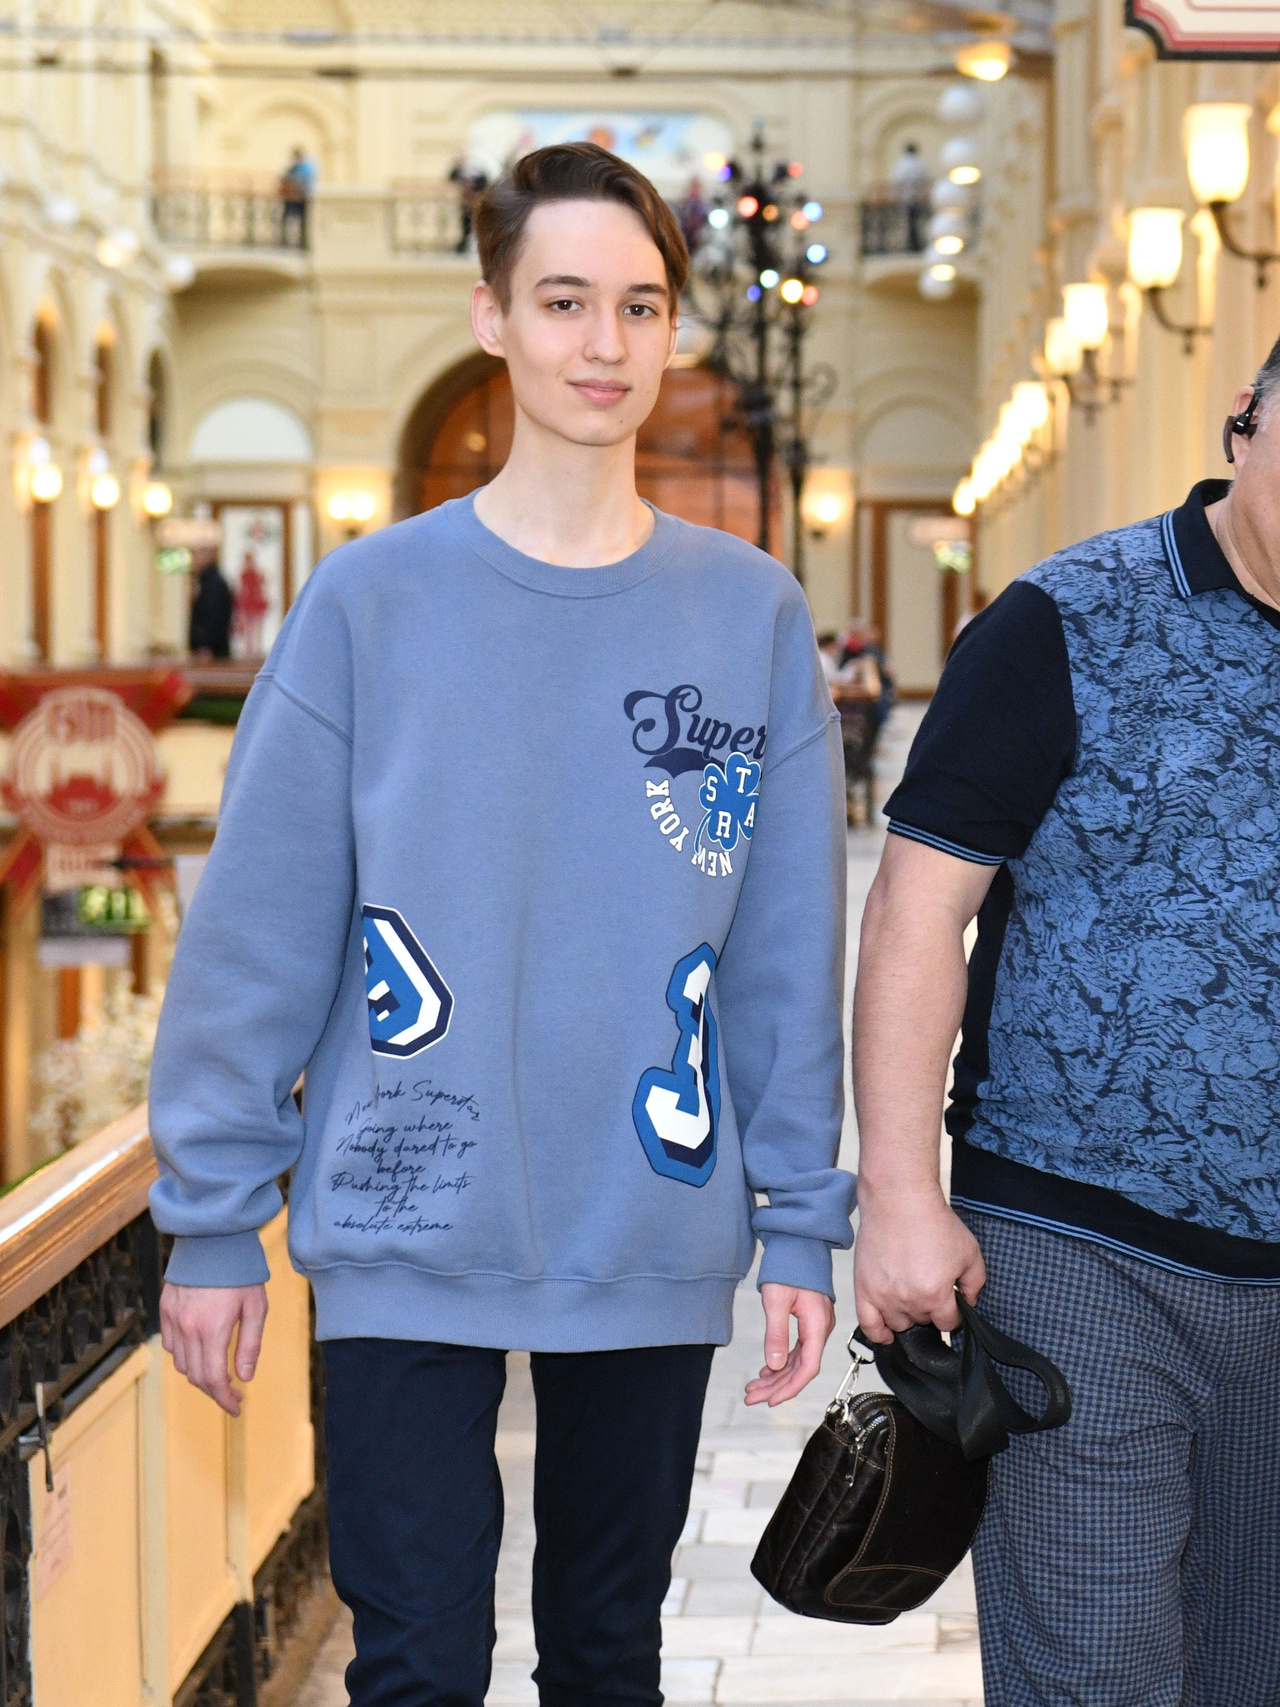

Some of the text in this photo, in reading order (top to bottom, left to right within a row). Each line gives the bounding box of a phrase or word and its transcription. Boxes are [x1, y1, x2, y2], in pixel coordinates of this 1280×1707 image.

[624, 684, 766, 760] Super
[646, 778, 733, 877] NEW YORK
[404, 1115, 453, 1132] where
[336, 1133, 477, 1162] Nobody dared to go
[376, 1159, 426, 1182] before
[328, 1172, 476, 1202] Pushing the limits
[374, 1195, 418, 1218] to the
[334, 1214, 453, 1236] absolute extreme
